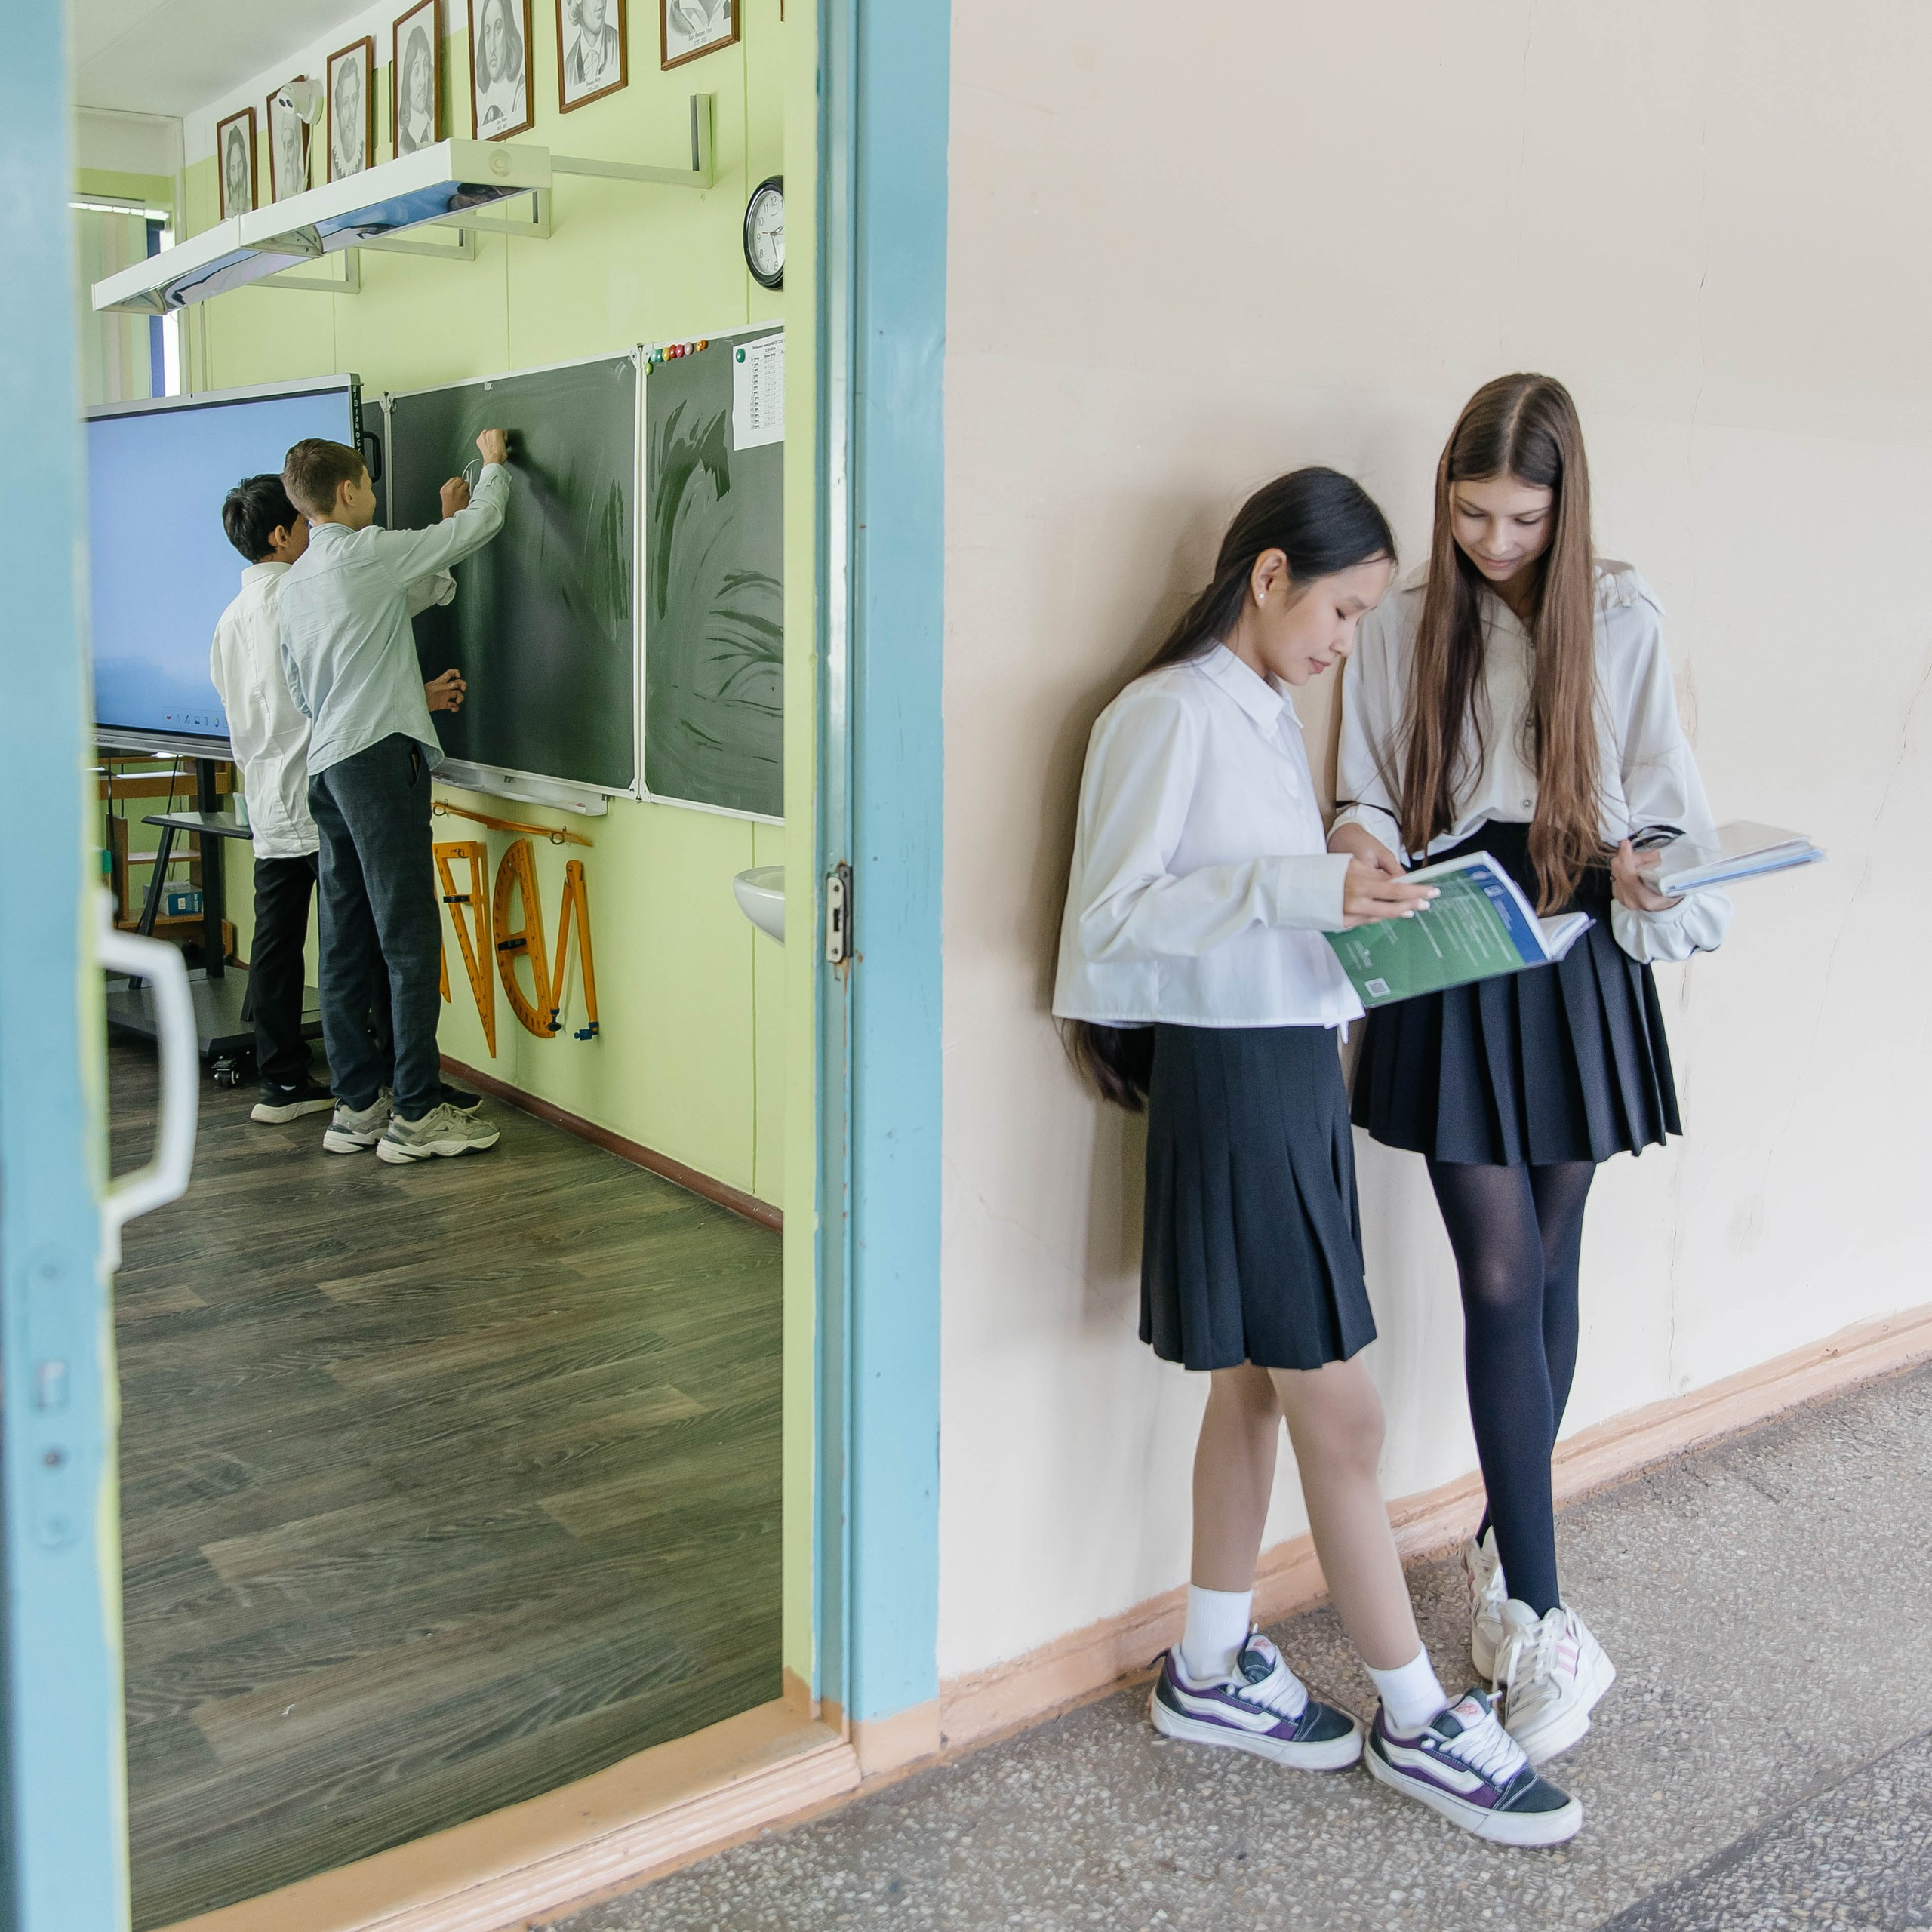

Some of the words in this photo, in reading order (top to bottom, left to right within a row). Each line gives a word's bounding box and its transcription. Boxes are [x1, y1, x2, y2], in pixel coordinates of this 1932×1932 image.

[771, 195, 777, 206] 12
[764, 203, 768, 213] 11
[758, 217, 764, 226] 10
[757, 233, 761, 243] 9
[759, 248, 764, 259] 8
[765, 259, 770, 269] 7
[774, 261, 778, 271] 6
